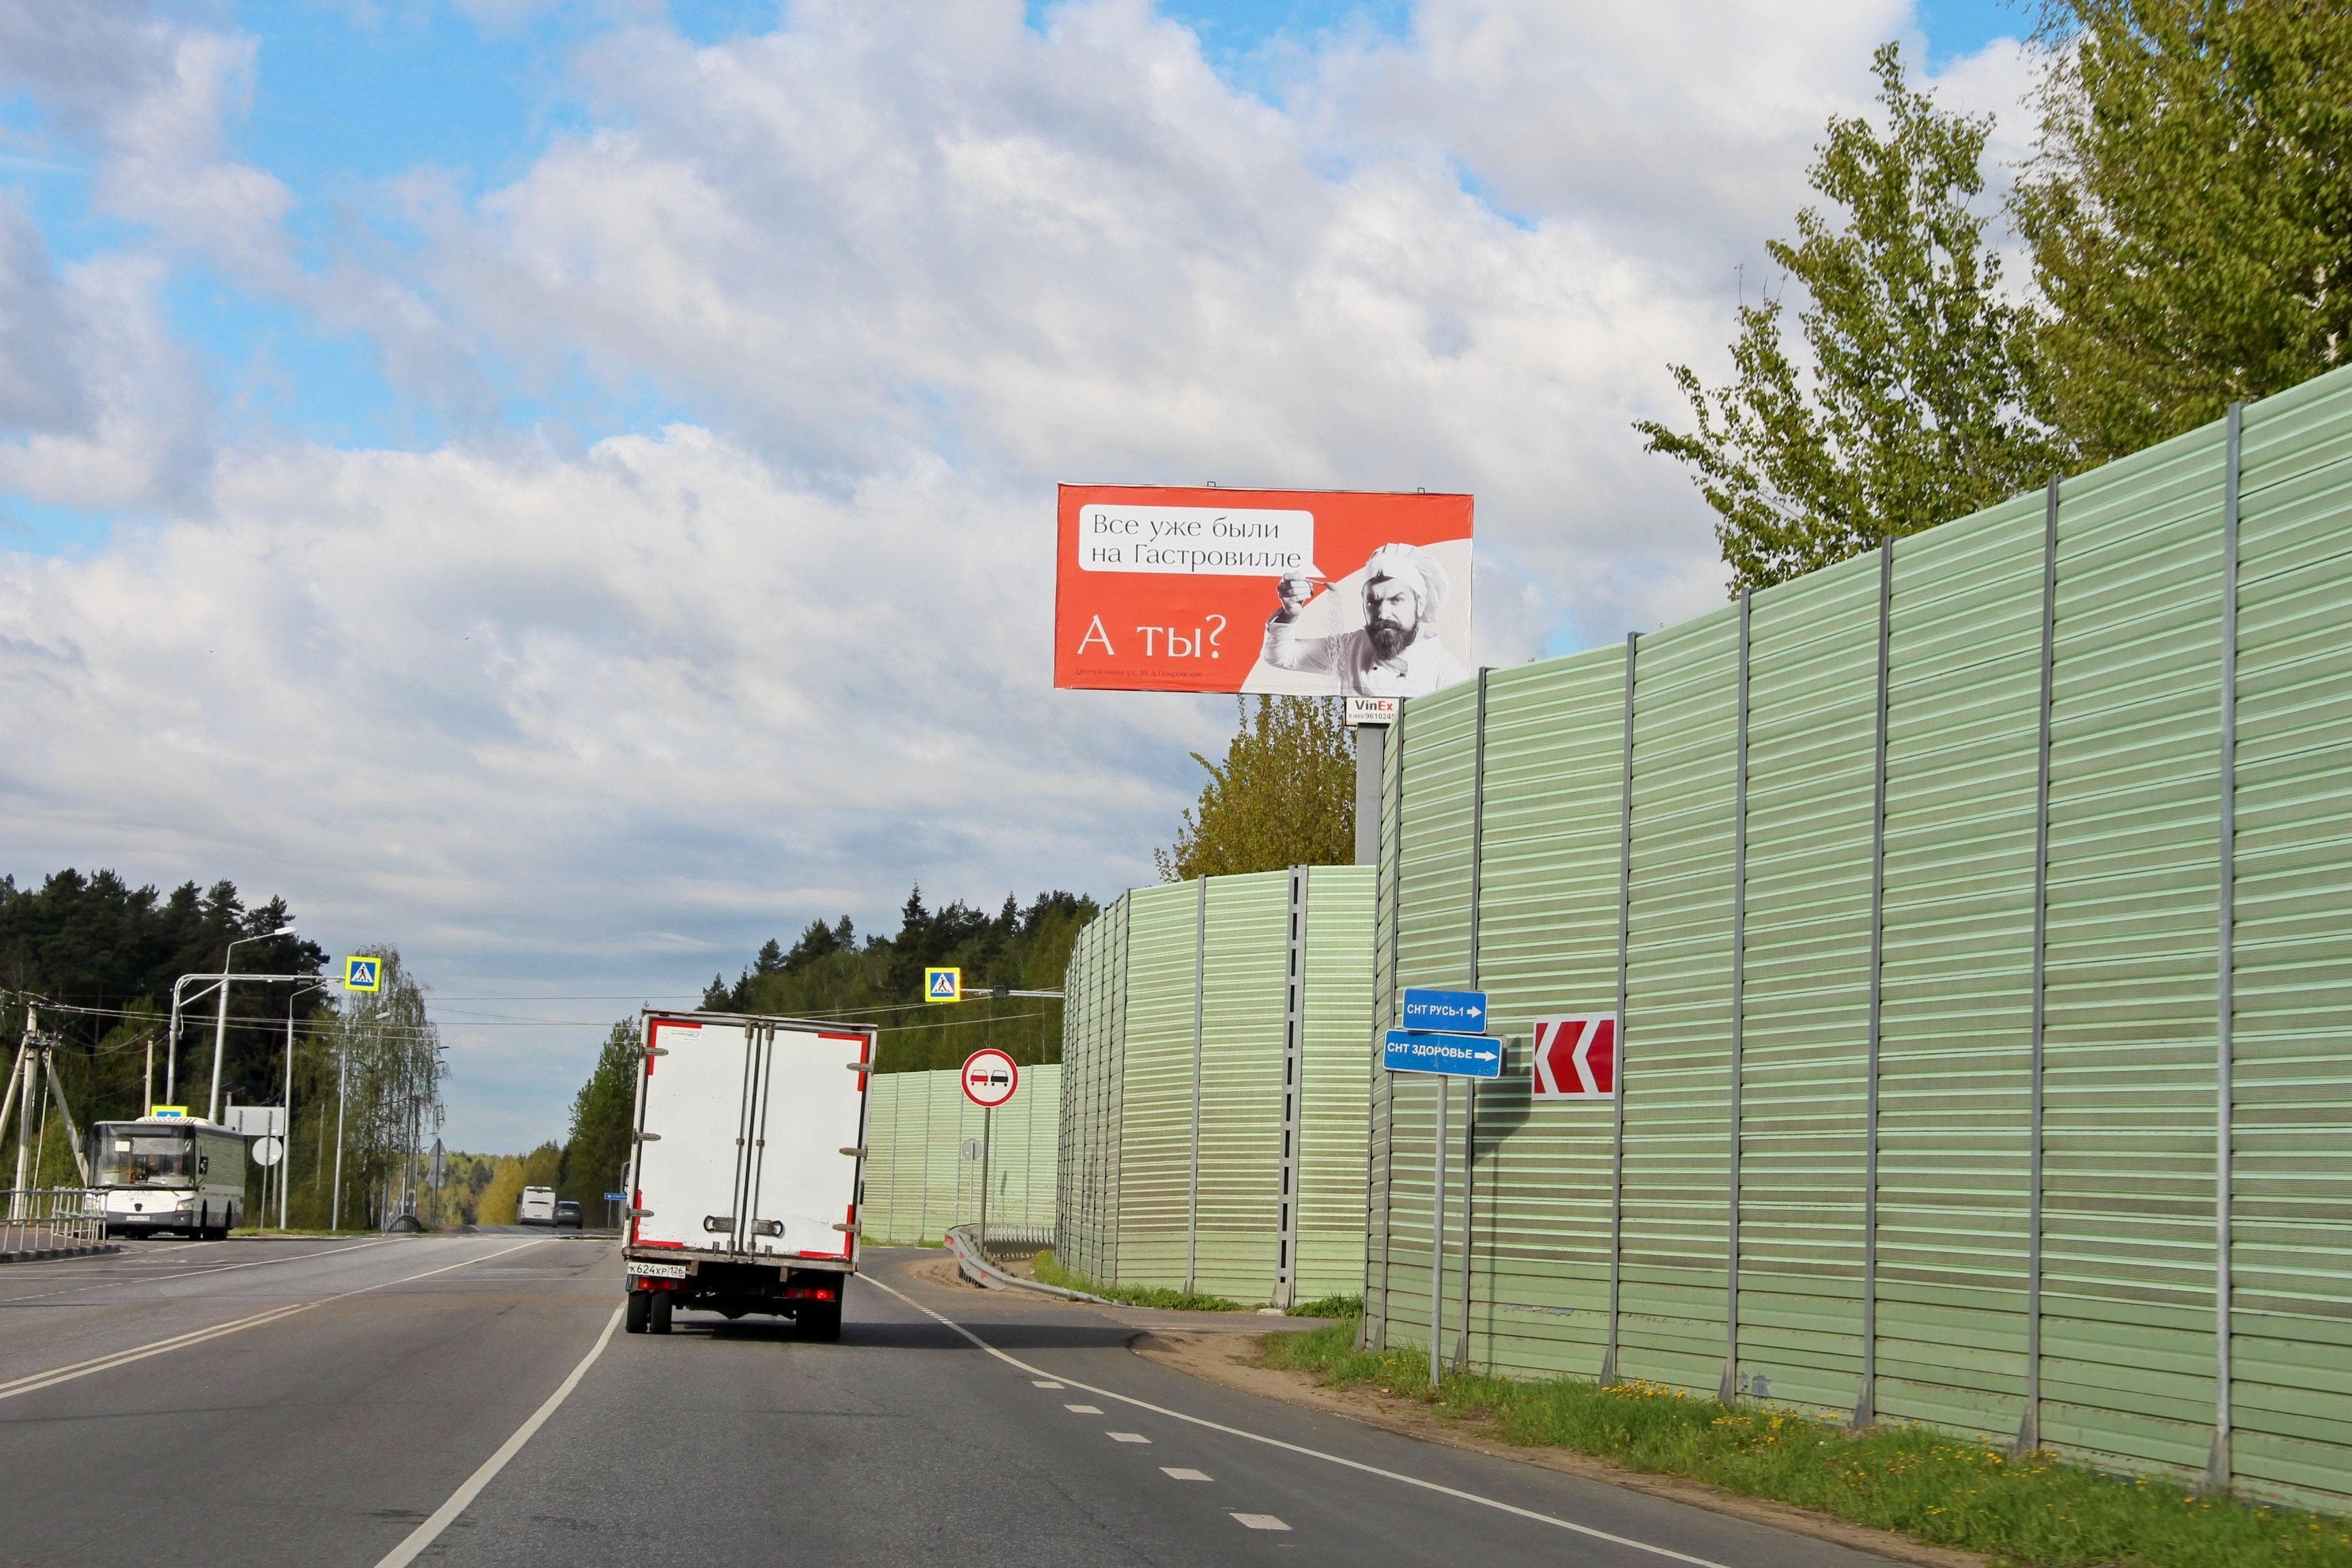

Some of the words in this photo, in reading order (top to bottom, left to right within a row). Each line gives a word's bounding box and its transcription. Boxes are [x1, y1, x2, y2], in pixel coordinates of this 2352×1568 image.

[1094, 514, 1139, 535] Все
[1149, 519, 1202, 542] уже
[1212, 514, 1279, 539] были
[1092, 546, 1122, 563] на
[1134, 544, 1301, 572] Гастровилле
[1077, 614, 1115, 655] А
[1136, 614, 1227, 659] ты?
[1355, 700, 1393, 711] VinEx
[1407, 1004, 1428, 1015] СНТ
[1429, 1005, 1465, 1017] РУСЬ-1
[1387, 1042, 1410, 1054] СНТ
[1411, 1043, 1473, 1060] ЗДОРОВЬЕ
